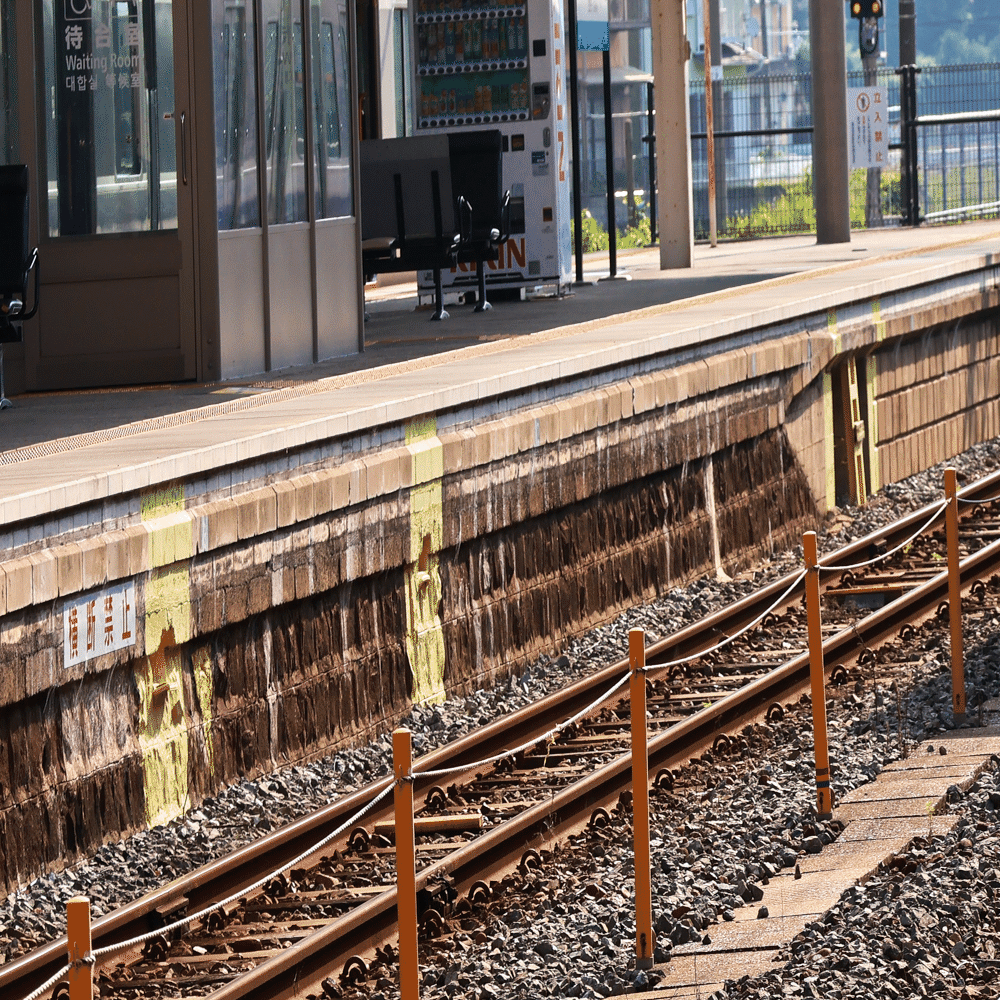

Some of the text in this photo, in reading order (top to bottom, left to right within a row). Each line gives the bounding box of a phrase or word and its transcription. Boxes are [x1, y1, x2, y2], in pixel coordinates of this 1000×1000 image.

[64, 22, 140, 50] 待合室
[65, 52, 140, 74] Waiting Room
[65, 74, 98, 92] 대합실
[873, 92, 883, 162] 立入禁止
[68, 589, 131, 660] 横断禁止
